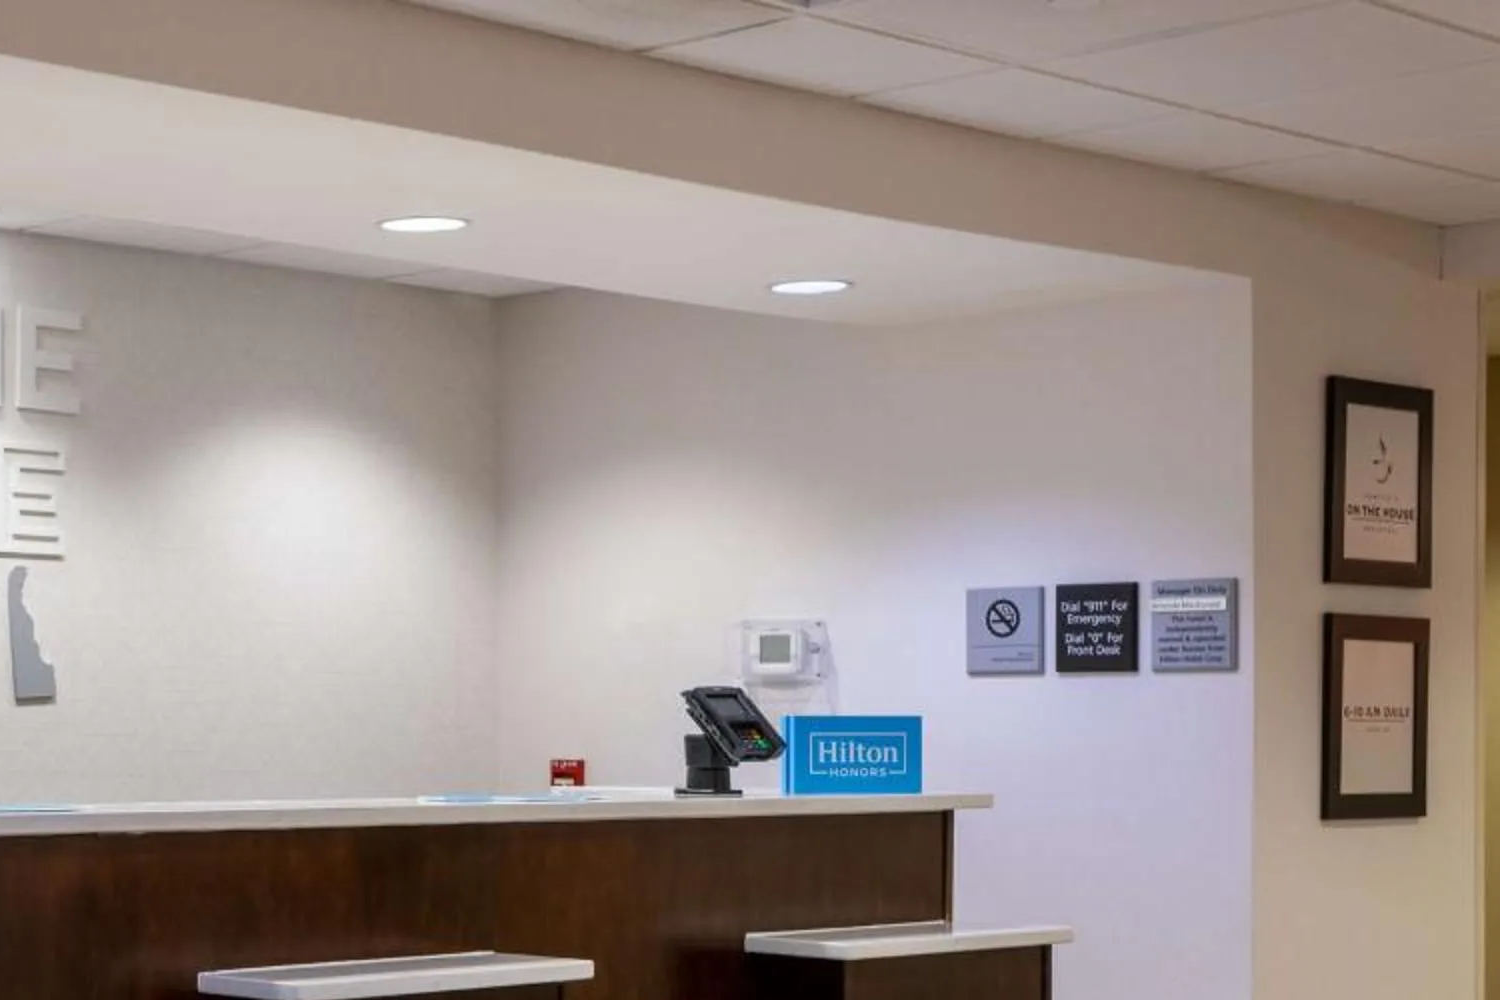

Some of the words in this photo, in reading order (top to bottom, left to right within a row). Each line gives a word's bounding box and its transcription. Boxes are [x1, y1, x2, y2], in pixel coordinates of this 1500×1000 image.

[1061, 601, 1080, 612] Dial
[1067, 614, 1122, 626] Emergency
[1065, 633, 1084, 643] Dial
[1067, 645, 1093, 656] Front
[1096, 645, 1121, 655] Desk
[818, 740, 898, 764] Hilton
[829, 767, 888, 778] HONORS
